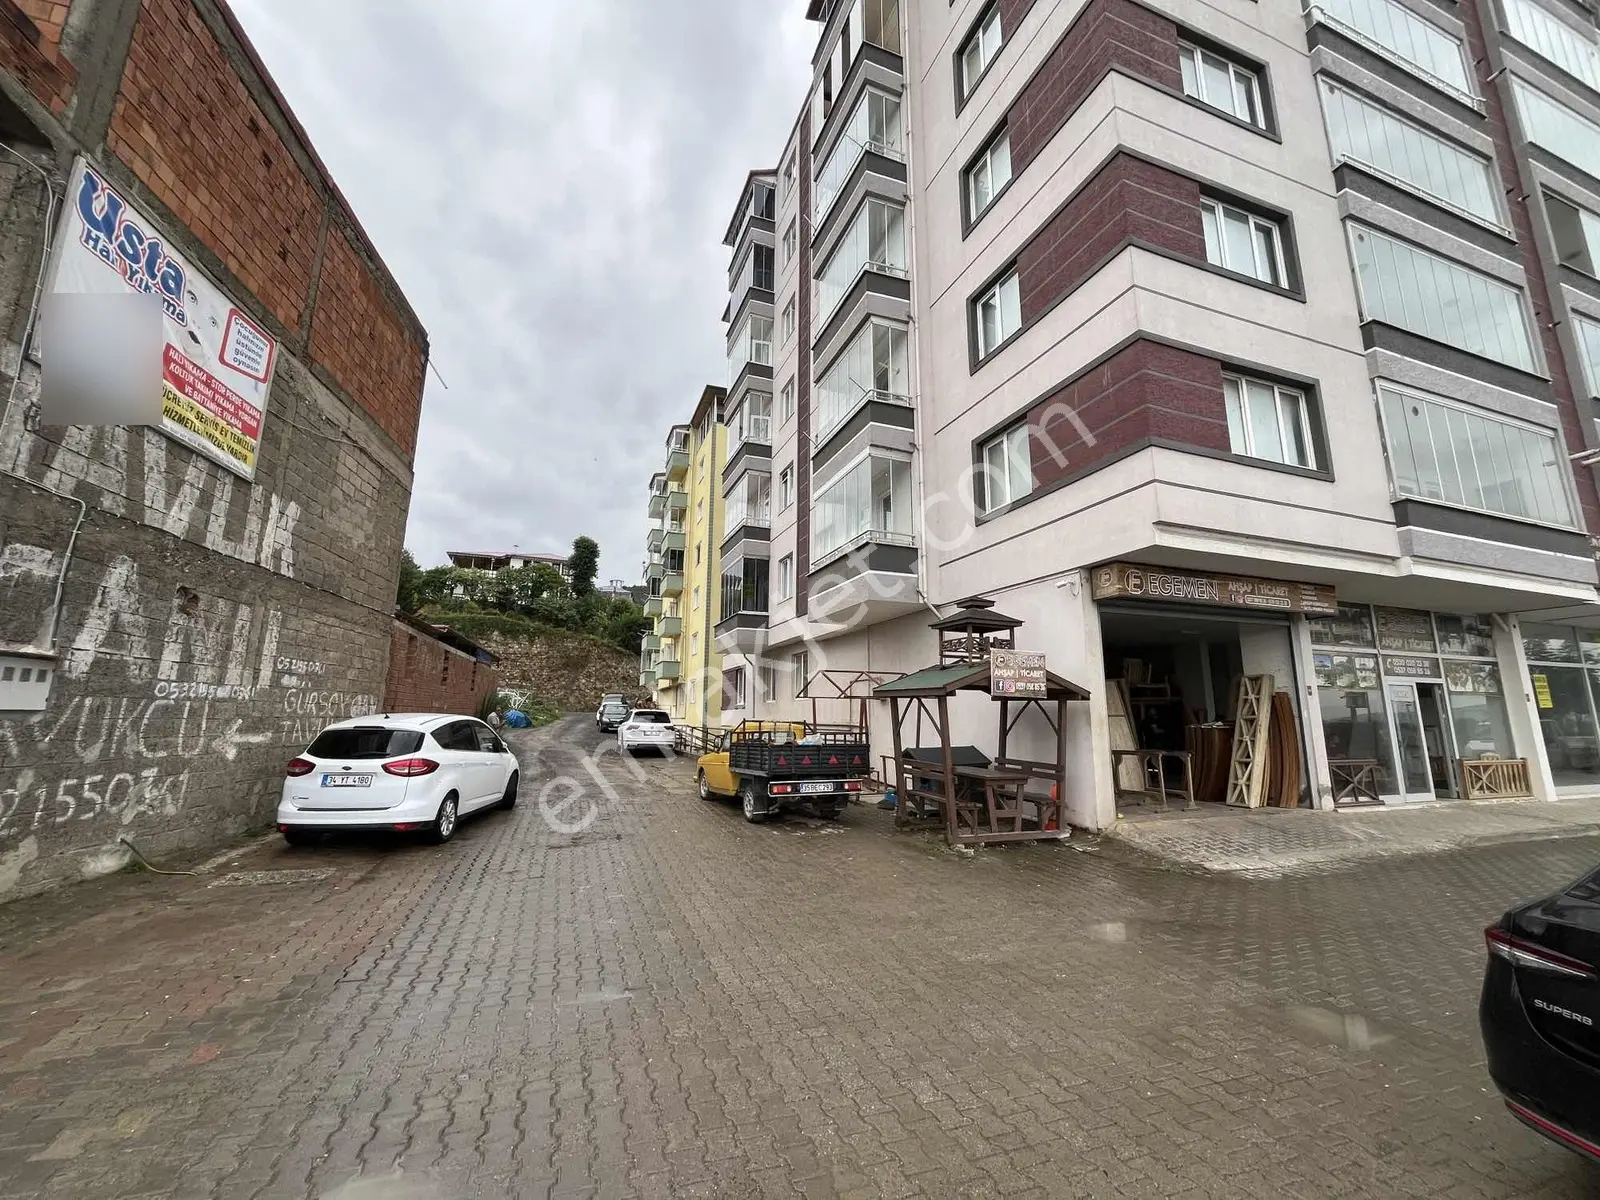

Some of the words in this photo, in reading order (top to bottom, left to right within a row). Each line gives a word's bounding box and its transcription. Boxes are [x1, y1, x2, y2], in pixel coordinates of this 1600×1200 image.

[77, 168, 186, 305] Usta
[184, 383, 193, 397] VE
[219, 425, 227, 438] EV
[1147, 572, 1219, 601] EGEMEN
[341, 776, 349, 784] YT
[1533, 998, 1593, 1026] SUPERB
